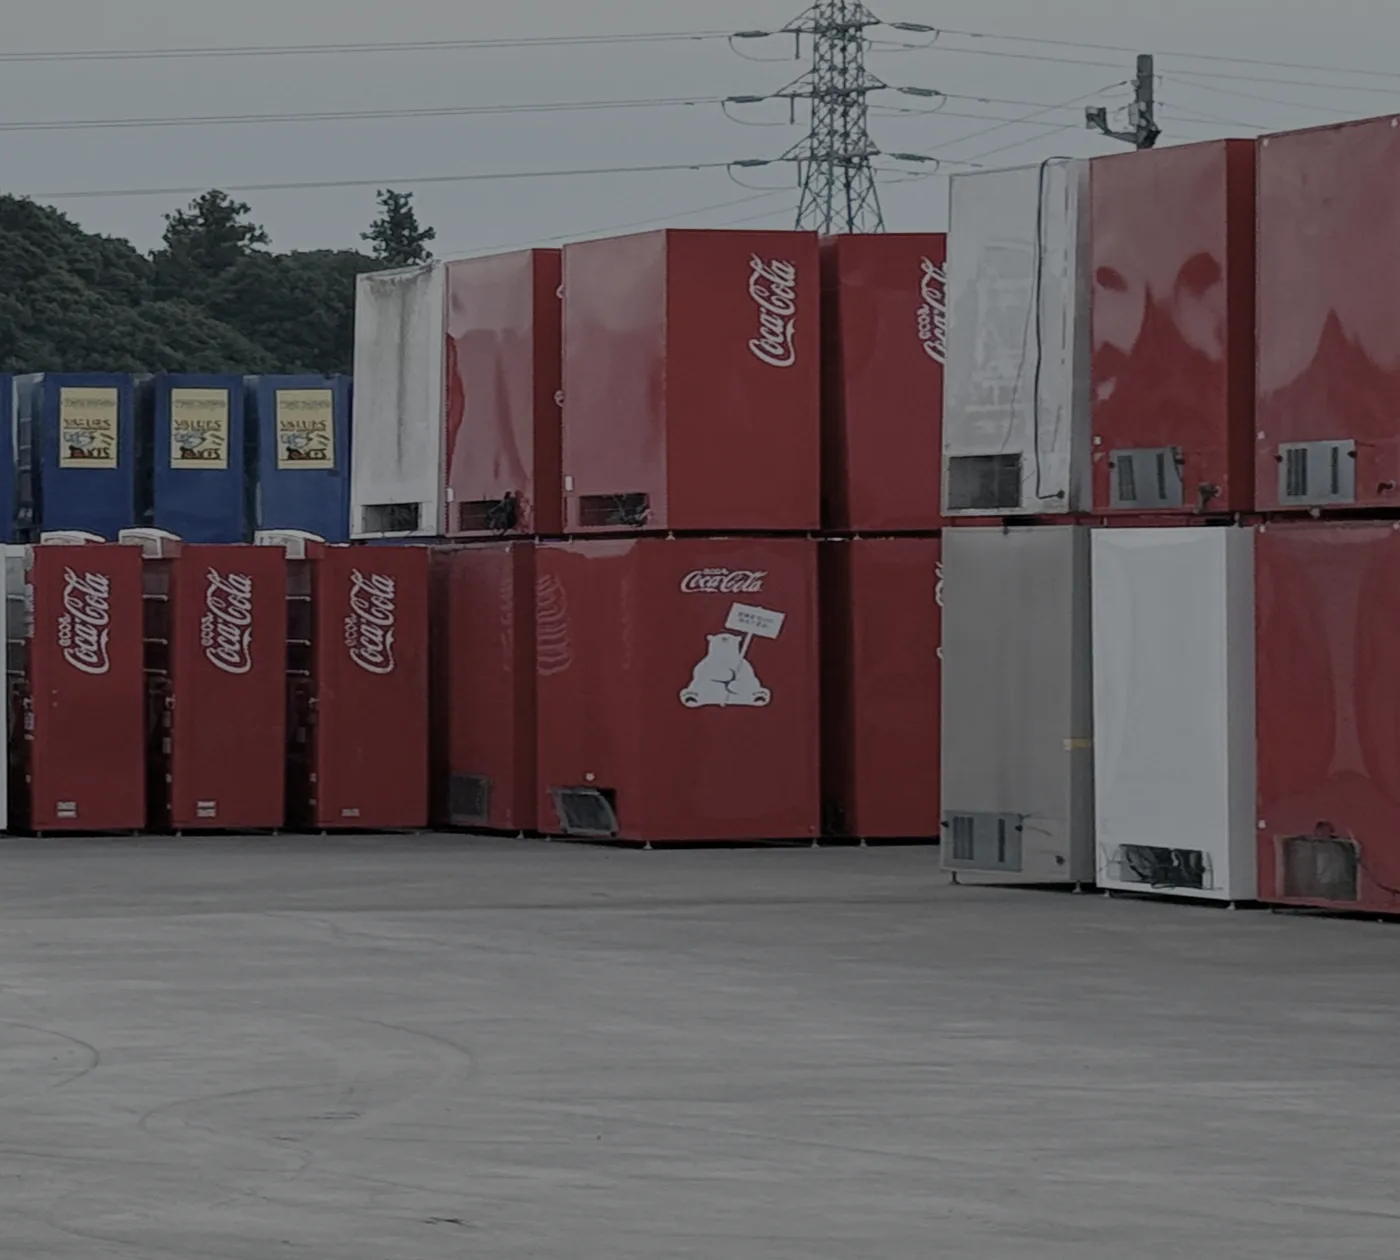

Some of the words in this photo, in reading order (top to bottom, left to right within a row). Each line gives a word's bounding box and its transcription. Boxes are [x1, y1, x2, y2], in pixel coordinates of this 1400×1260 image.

[63, 565, 110, 675] Coca-Cola
[206, 566, 252, 674] Coca-Cola
[349, 568, 395, 674] Coca-Cola
